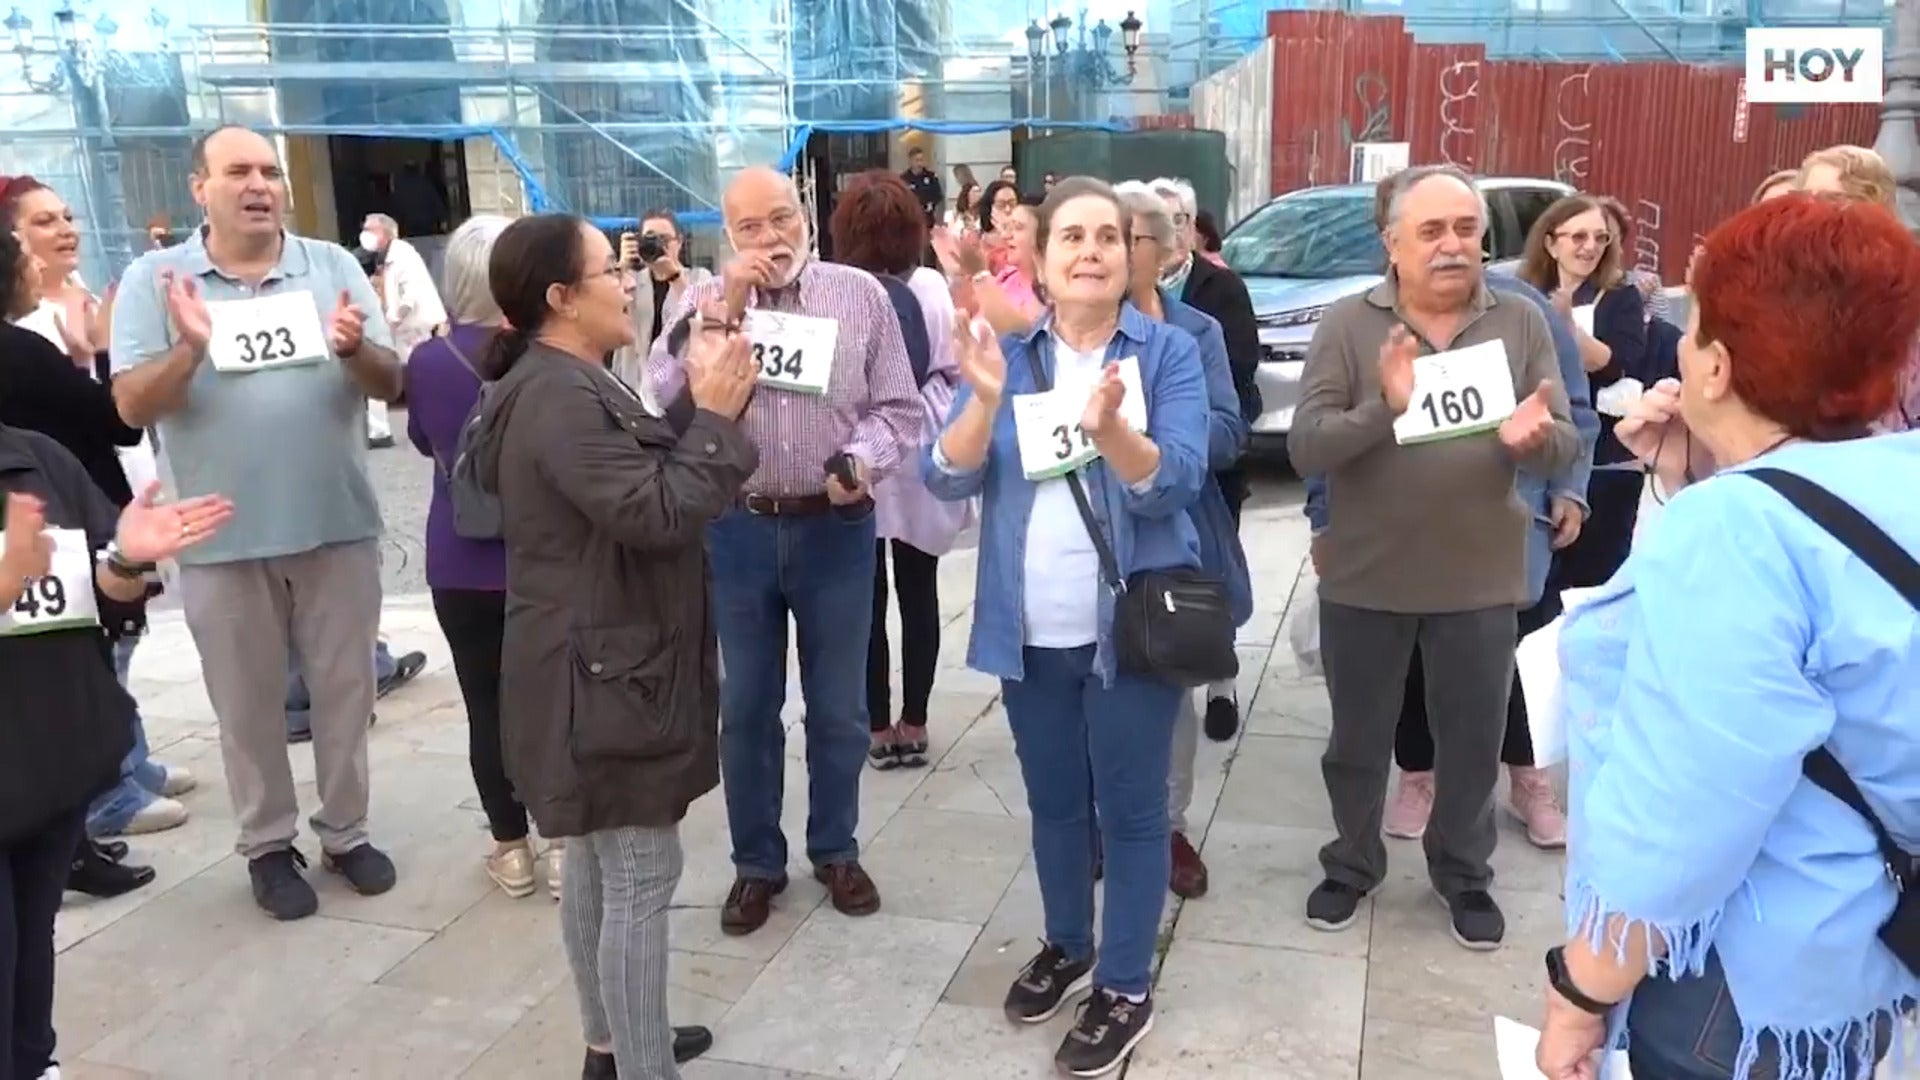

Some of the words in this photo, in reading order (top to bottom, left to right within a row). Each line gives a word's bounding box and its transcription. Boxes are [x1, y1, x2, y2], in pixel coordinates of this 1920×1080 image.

[236, 327, 296, 363] 323
[752, 343, 803, 380] 334
[1422, 386, 1484, 428] 160
